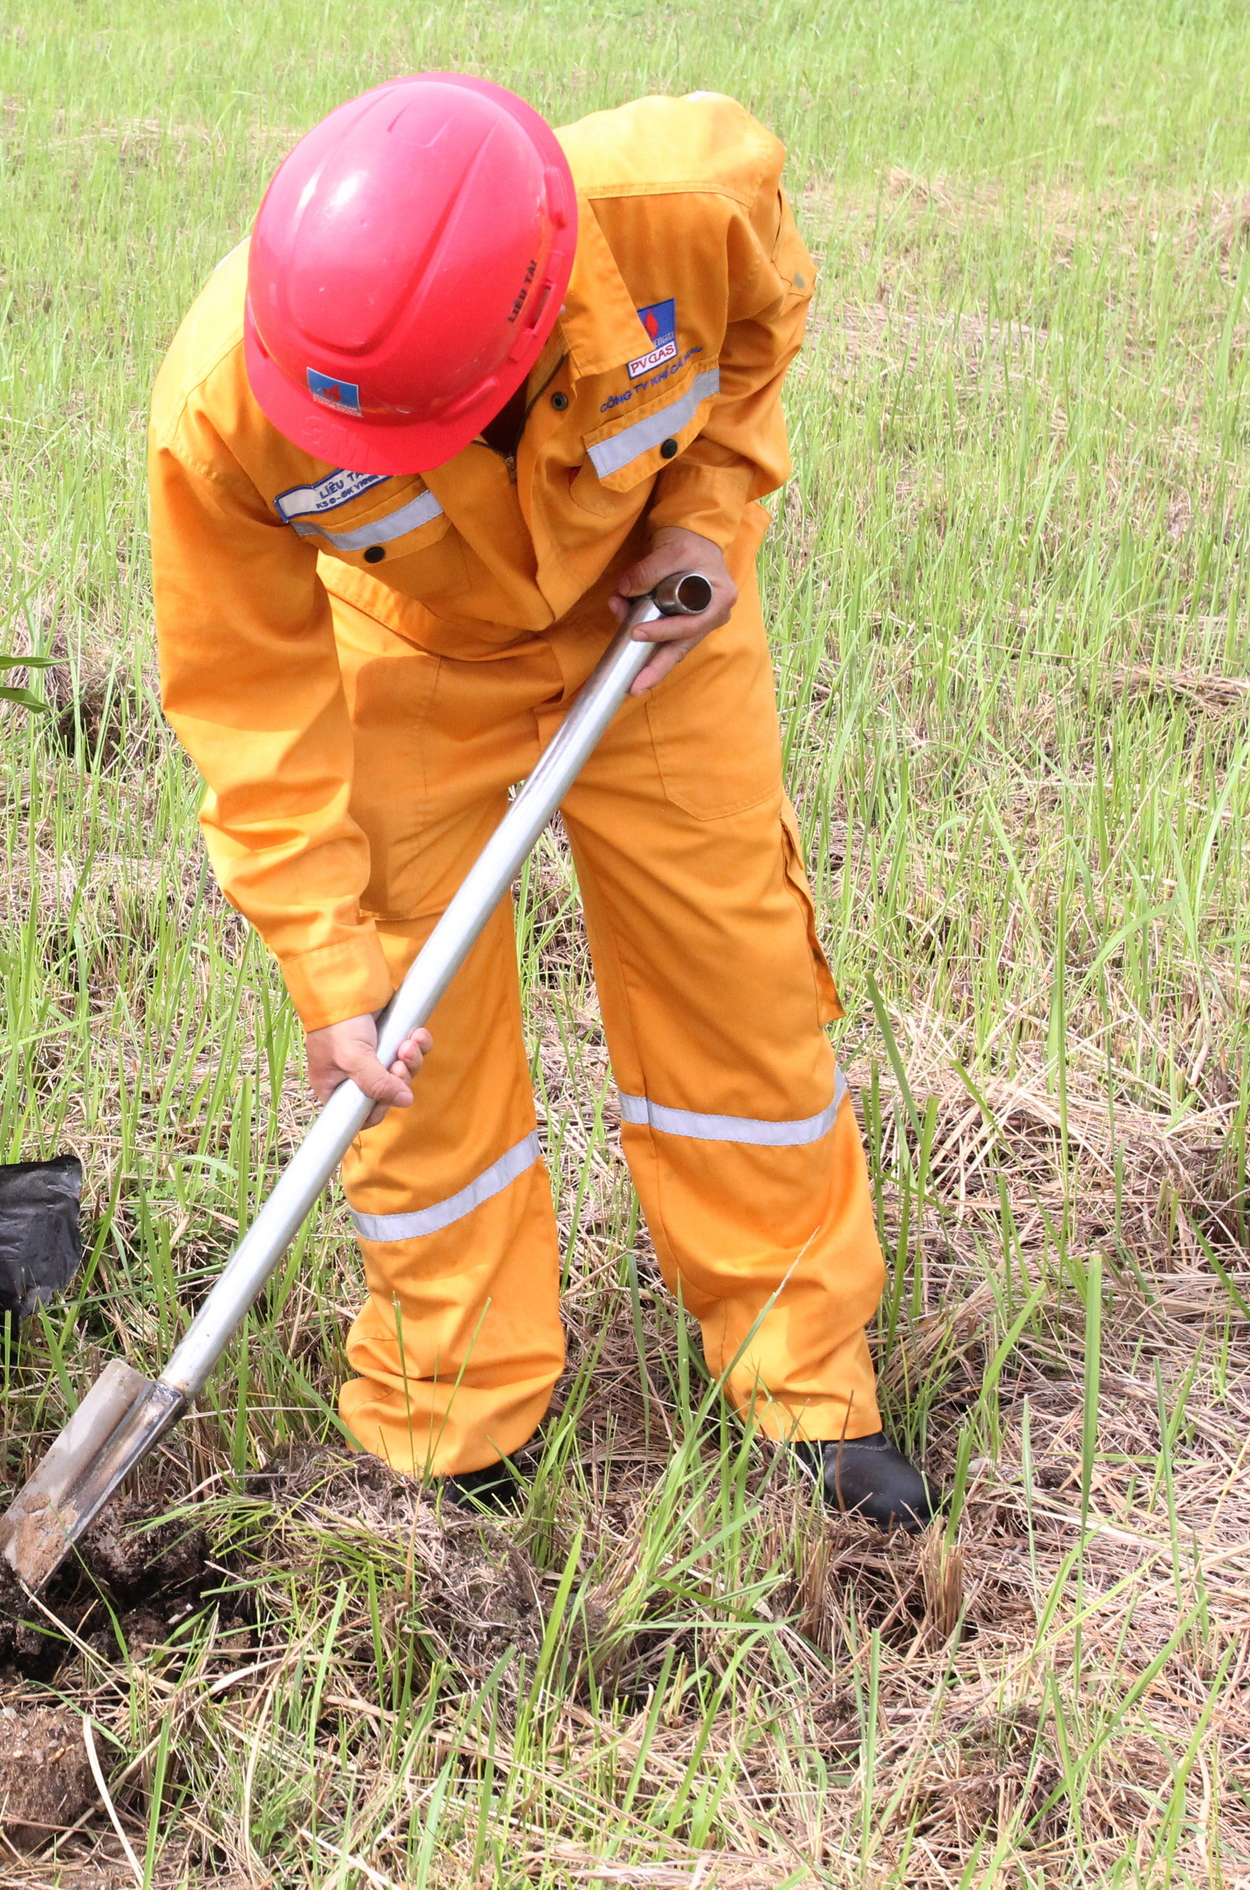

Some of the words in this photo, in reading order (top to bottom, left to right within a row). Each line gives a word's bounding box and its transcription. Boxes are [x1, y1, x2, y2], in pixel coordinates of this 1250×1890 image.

[630, 360, 648, 374] PV
[648, 344, 675, 364] GAS
[599, 389, 632, 413] CÔNG
[633, 382, 649, 394] TY
